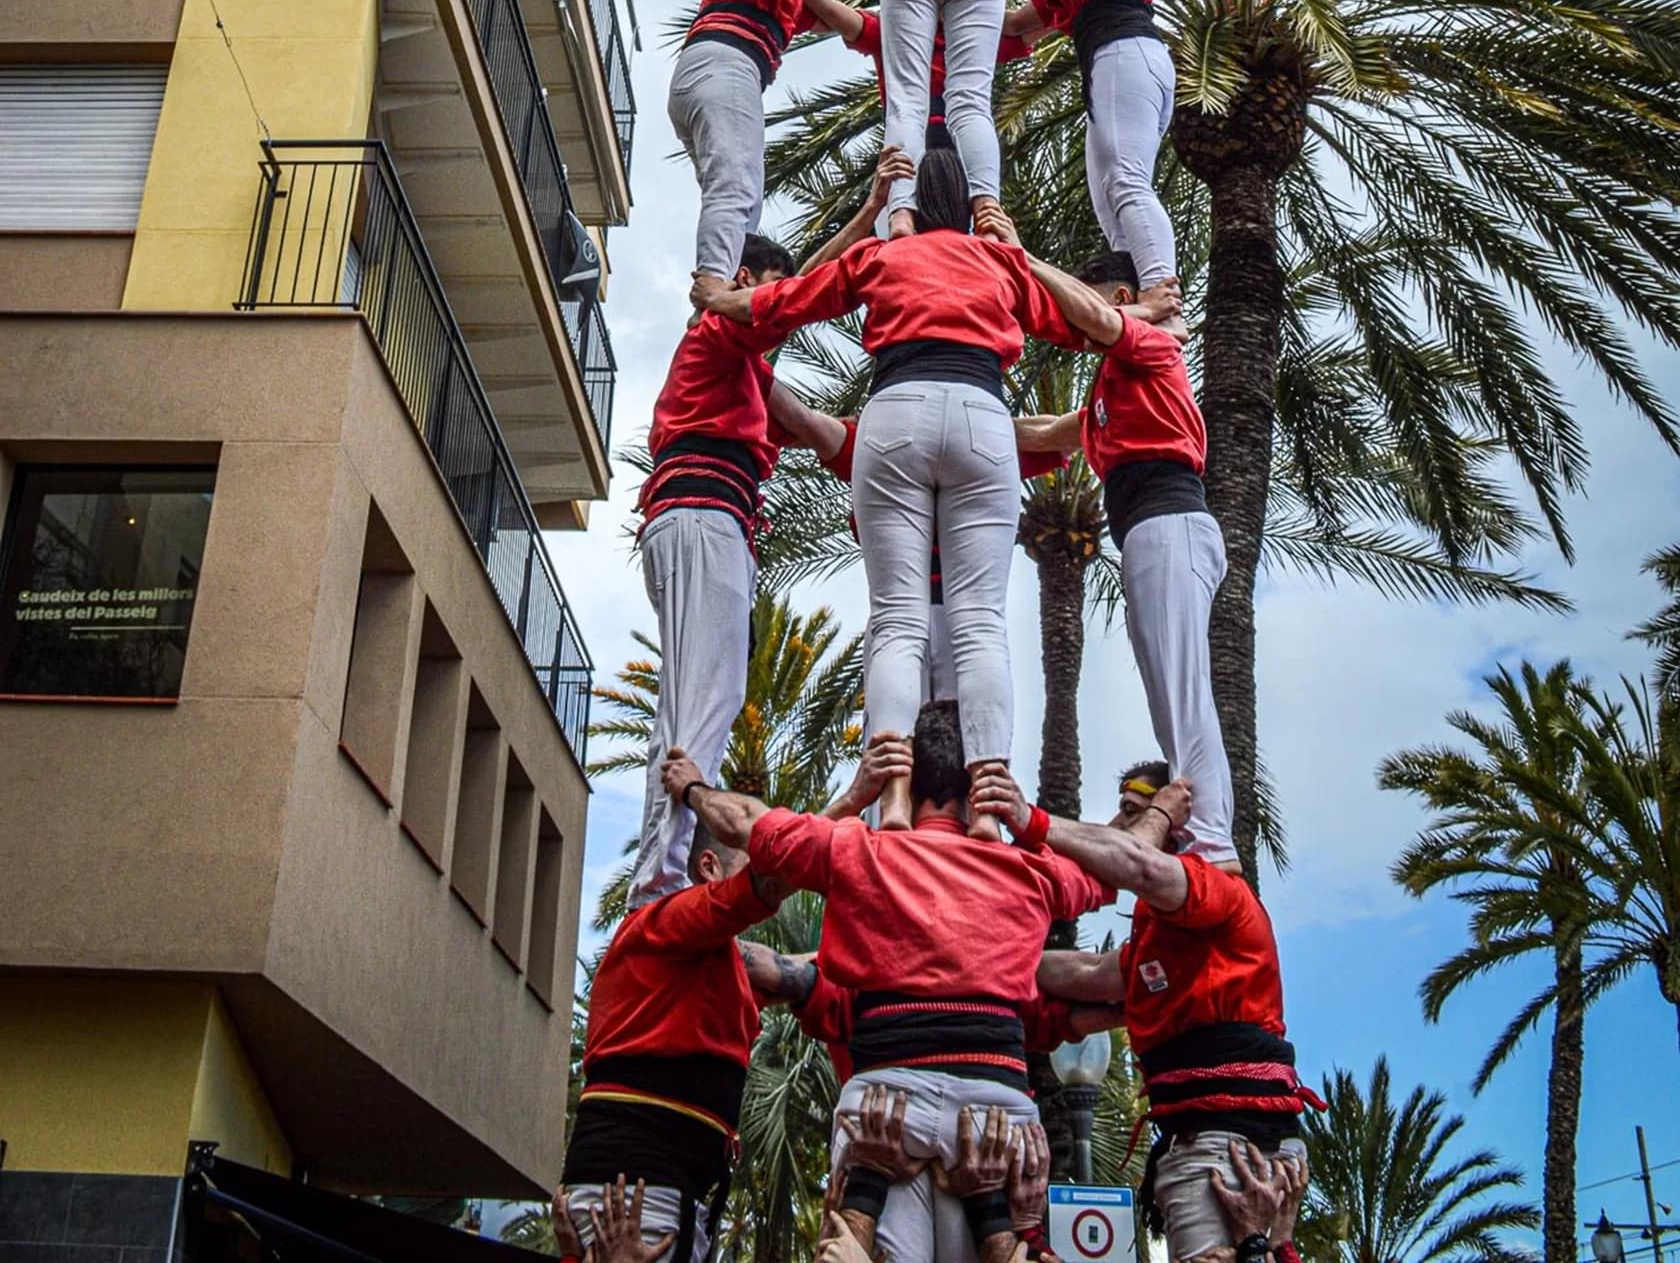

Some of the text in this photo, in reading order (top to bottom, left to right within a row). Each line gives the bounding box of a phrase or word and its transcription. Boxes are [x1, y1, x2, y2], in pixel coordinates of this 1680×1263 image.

[19, 590, 85, 602] Gaudeix
[88, 589, 110, 601] de
[112, 589, 136, 601] les
[15, 605, 157, 620] vistes del Passeig
